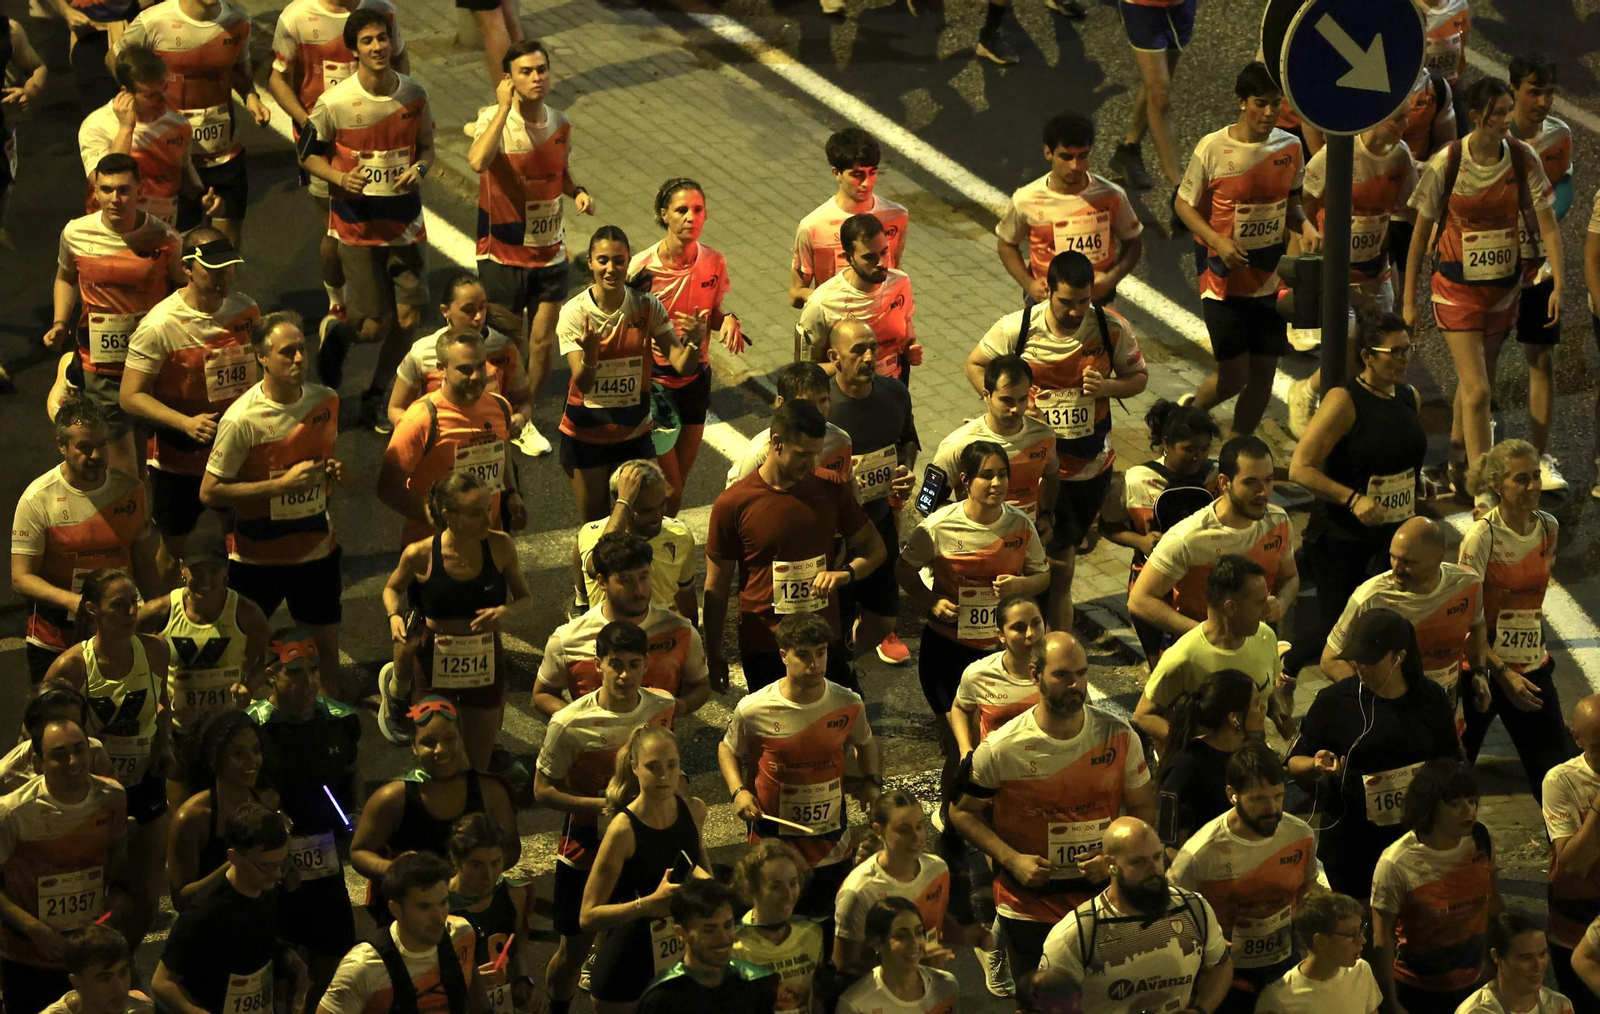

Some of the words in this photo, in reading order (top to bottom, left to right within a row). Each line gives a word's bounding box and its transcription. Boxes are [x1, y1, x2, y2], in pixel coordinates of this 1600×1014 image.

[1239, 219, 1279, 238] 22054
[1066, 234, 1102, 251] 7446
[1469, 248, 1511, 267] 24960
[701, 277, 717, 289] KH7
[234, 321, 252, 333] KH7
[217, 365, 246, 386] 5148
[593, 377, 636, 394] 14450
[313, 411, 329, 424] KH7
[1043, 408, 1088, 426] 13150
[1030, 449, 1046, 460] KH7
[114, 502, 135, 515] KH7
[1004, 538, 1022, 549] KH7
[1264, 537, 1281, 551] KH7
[780, 580, 813, 600] 125
[970, 607, 996, 625] 801
[1448, 600, 1468, 616] KH7
[649, 639, 674, 652] KH7
[1501, 630, 1539, 649] 24792
[440, 654, 488, 673] 12514
[186, 688, 226, 708] 8781
[827, 717, 847, 729] KH7
[1091, 751, 1114, 767] KH7
[1374, 791, 1403, 811] 166
[792, 803, 831, 823] 3557
[1280, 852, 1301, 866] KH7
[46, 891, 96, 917] 21357
[1244, 937, 1283, 955] 8964
[1135, 974, 1193, 993] Avanza
